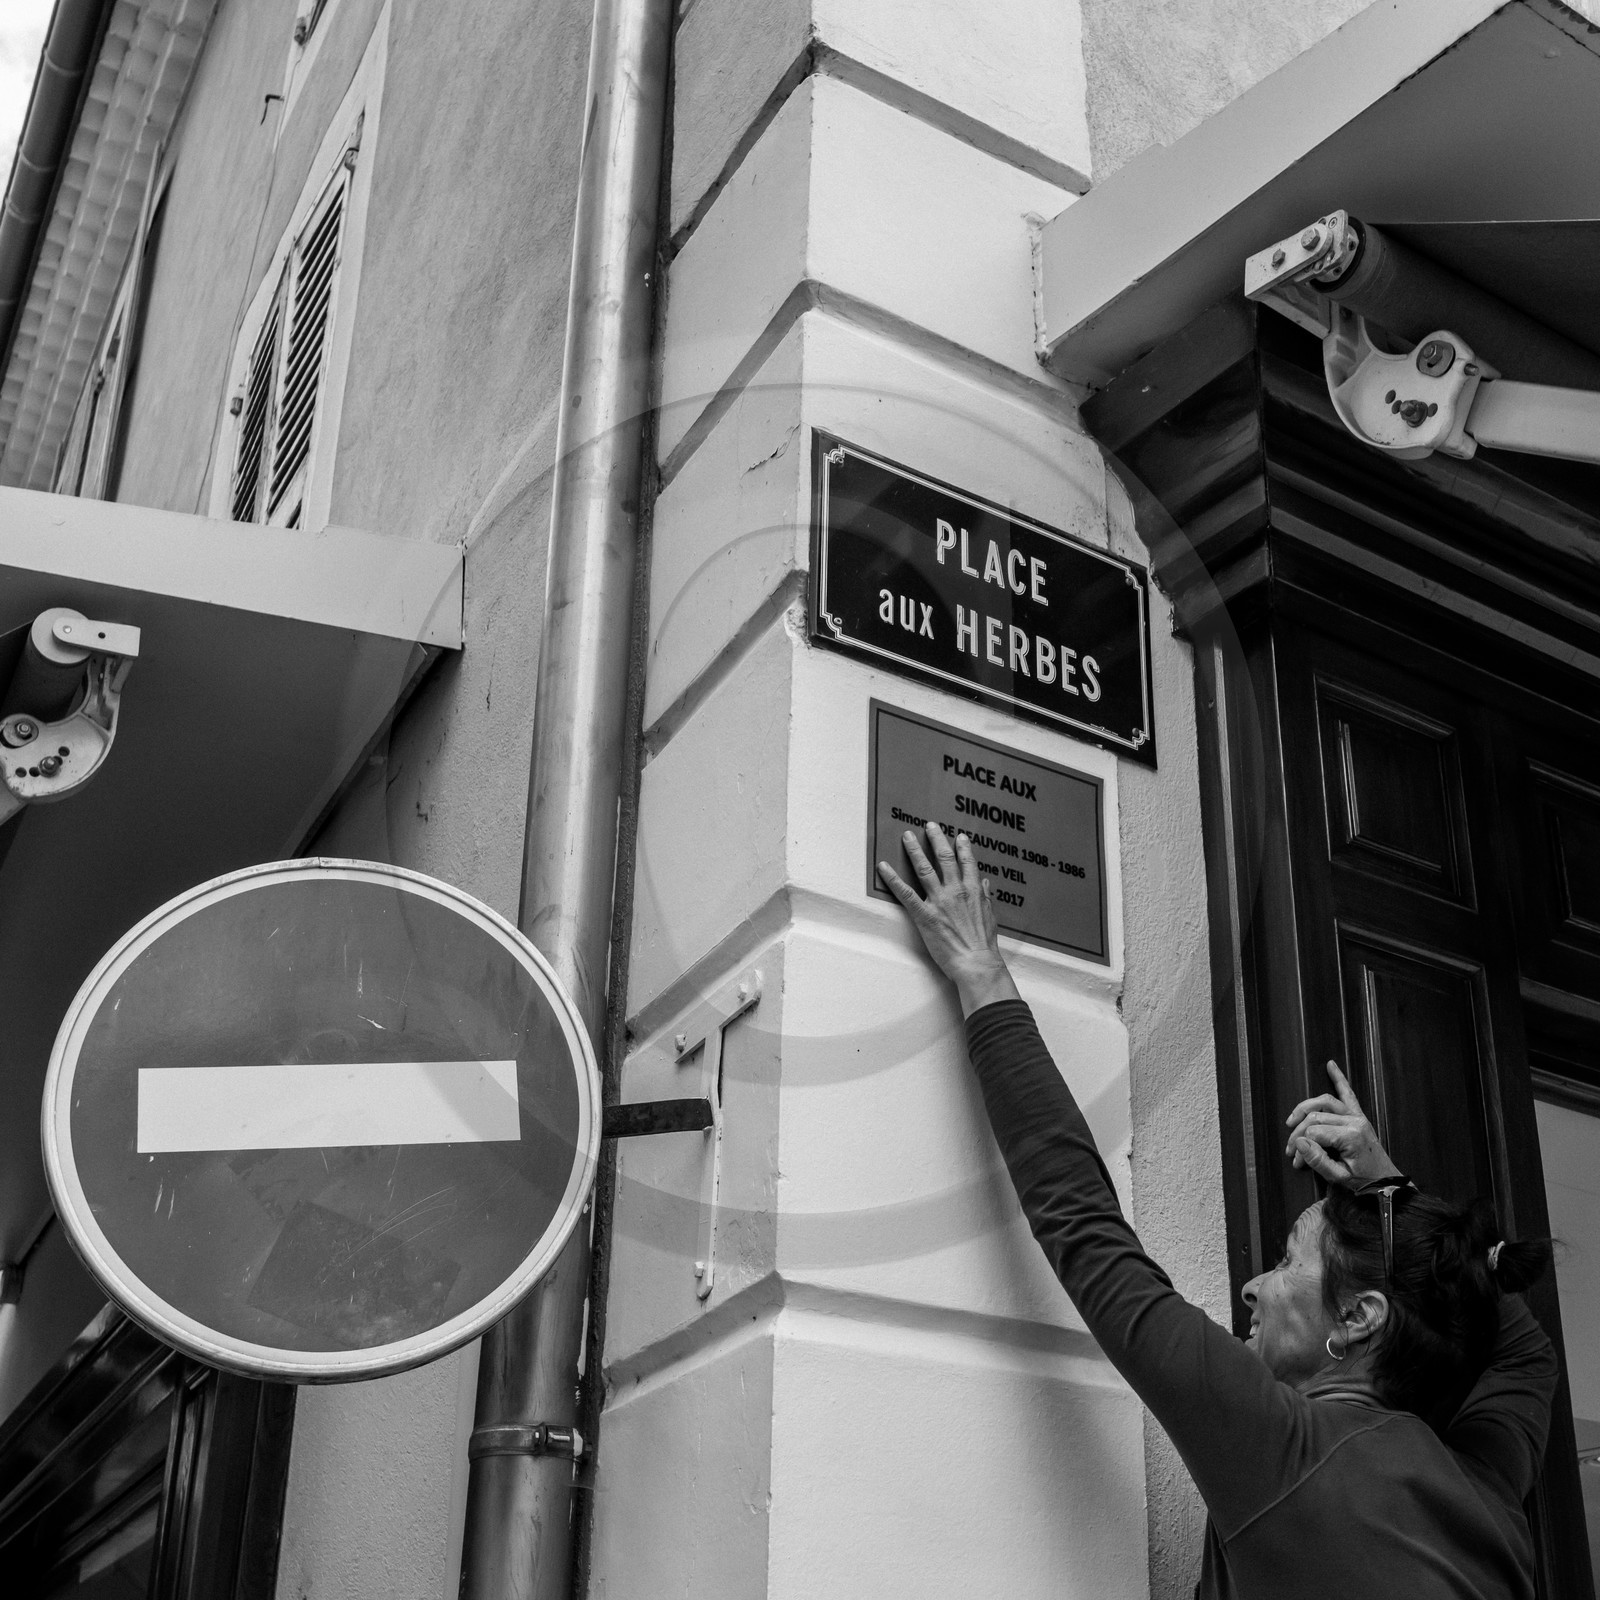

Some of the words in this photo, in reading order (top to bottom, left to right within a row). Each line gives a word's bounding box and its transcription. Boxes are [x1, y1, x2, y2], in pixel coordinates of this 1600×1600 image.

[936, 517, 1049, 606] PLACE
[878, 588, 935, 640] aux
[956, 604, 1102, 702] HERBES
[943, 755, 996, 787] PLACE
[1000, 775, 1037, 801] AUX
[955, 794, 1026, 833] SIMONE
[891, 806, 929, 829] Simon
[939, 822, 955, 838] DE
[1022, 849, 1049, 868] 1908
[1058, 861, 1086, 879] 1986
[1001, 865, 1027, 884] VEIL
[996, 889, 1025, 907] 2017
